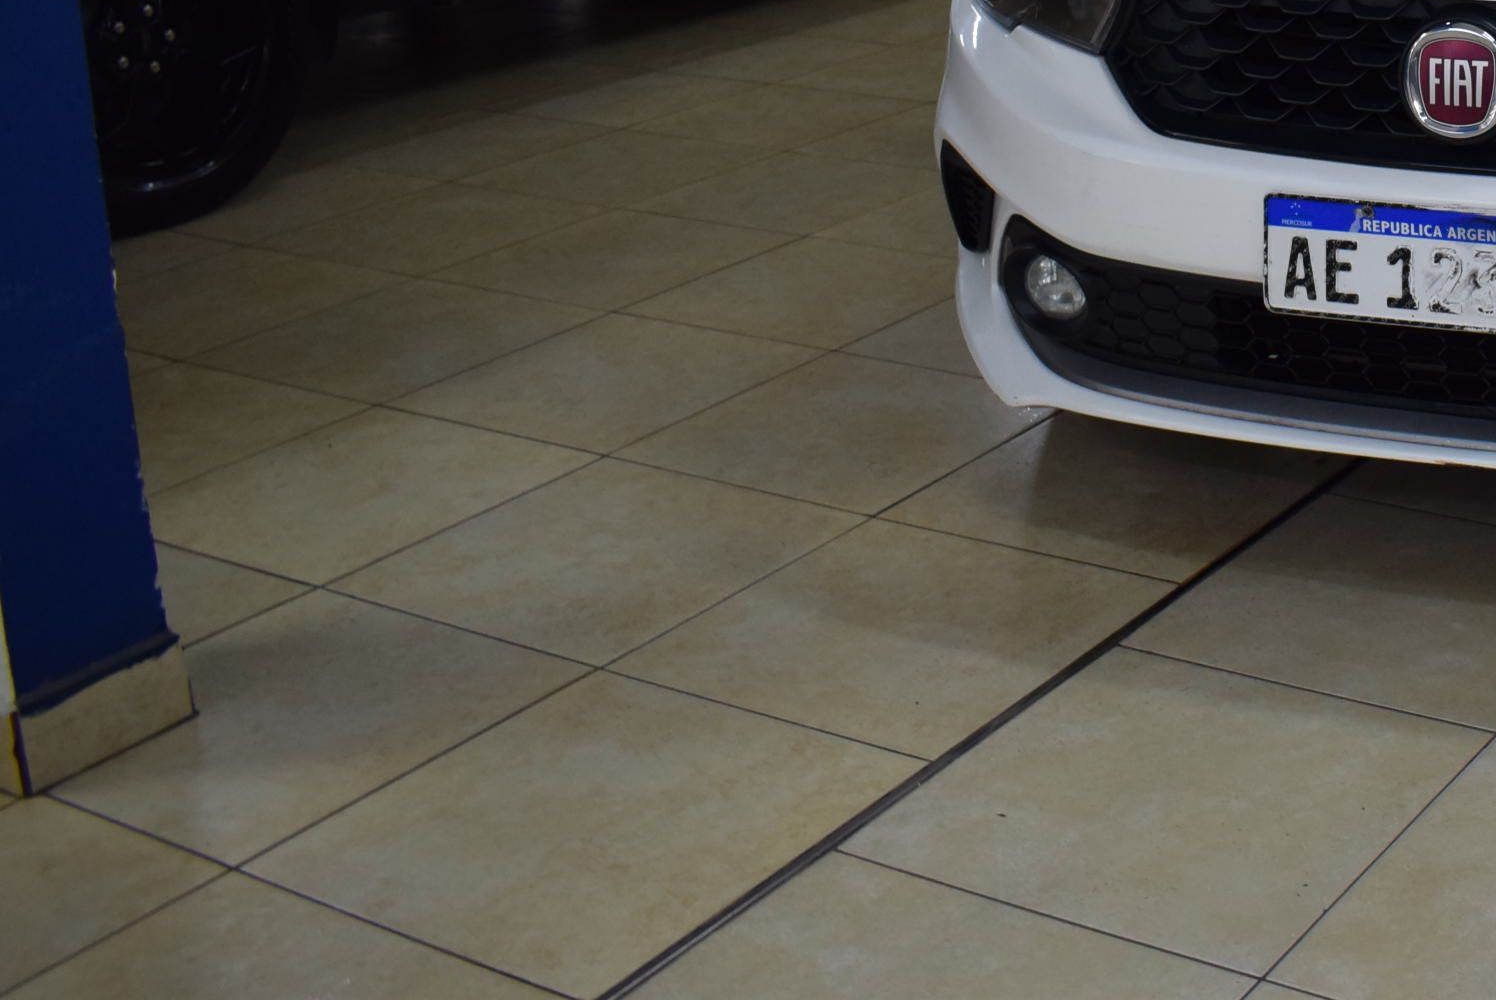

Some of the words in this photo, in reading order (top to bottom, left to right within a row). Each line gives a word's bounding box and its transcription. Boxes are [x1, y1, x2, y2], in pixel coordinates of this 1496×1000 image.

[1428, 57, 1489, 108] FIAT
[1281, 218, 1313, 228] MERCOSUR
[1362, 219, 1443, 239] REPUBLICA
[1284, 236, 1360, 305] AE
